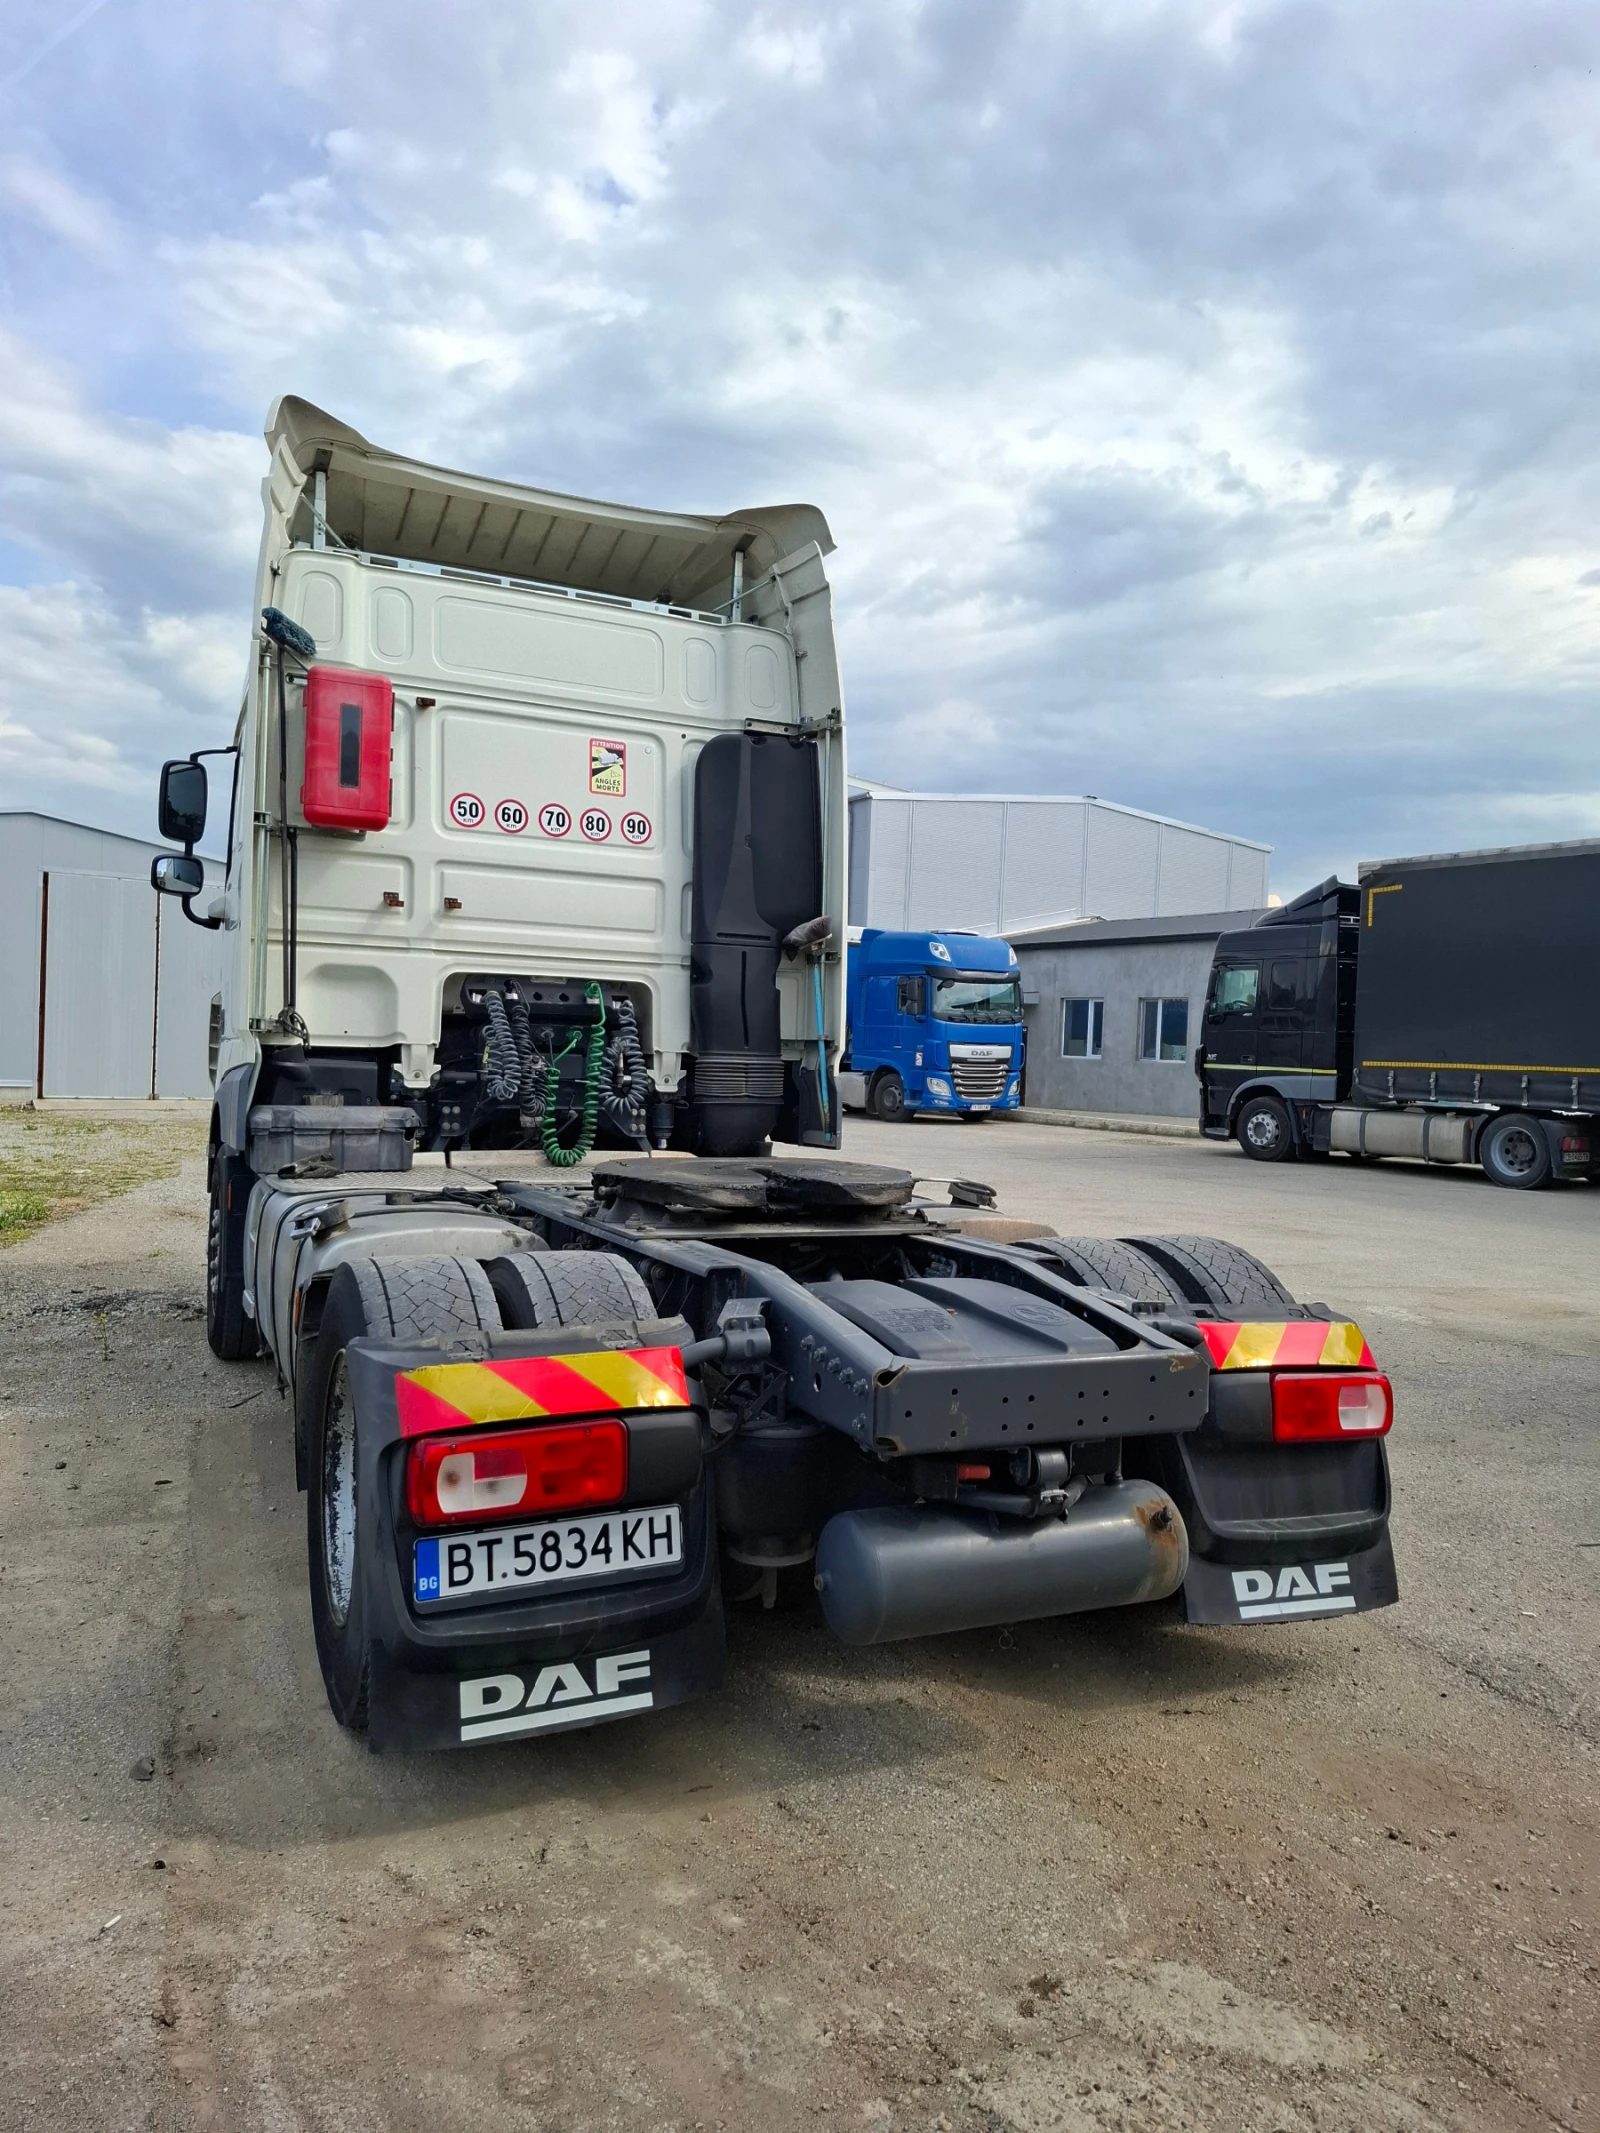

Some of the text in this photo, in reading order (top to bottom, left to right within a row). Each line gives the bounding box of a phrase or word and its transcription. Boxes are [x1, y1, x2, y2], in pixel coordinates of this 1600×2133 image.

[592, 740, 625, 750] ATTENTION
[595, 777, 621, 787] ANGLES
[596, 783, 620, 792] MORTS
[457, 800, 479, 818] 50
[501, 807, 522, 824] 60
[545, 810, 566, 827] 70
[585, 815, 606, 832] 80
[626, 818, 647, 835] 90
[419, 1576, 438, 1591] BG
[1231, 1562, 1351, 1602] DAF
[460, 1649, 651, 1719] DAF
